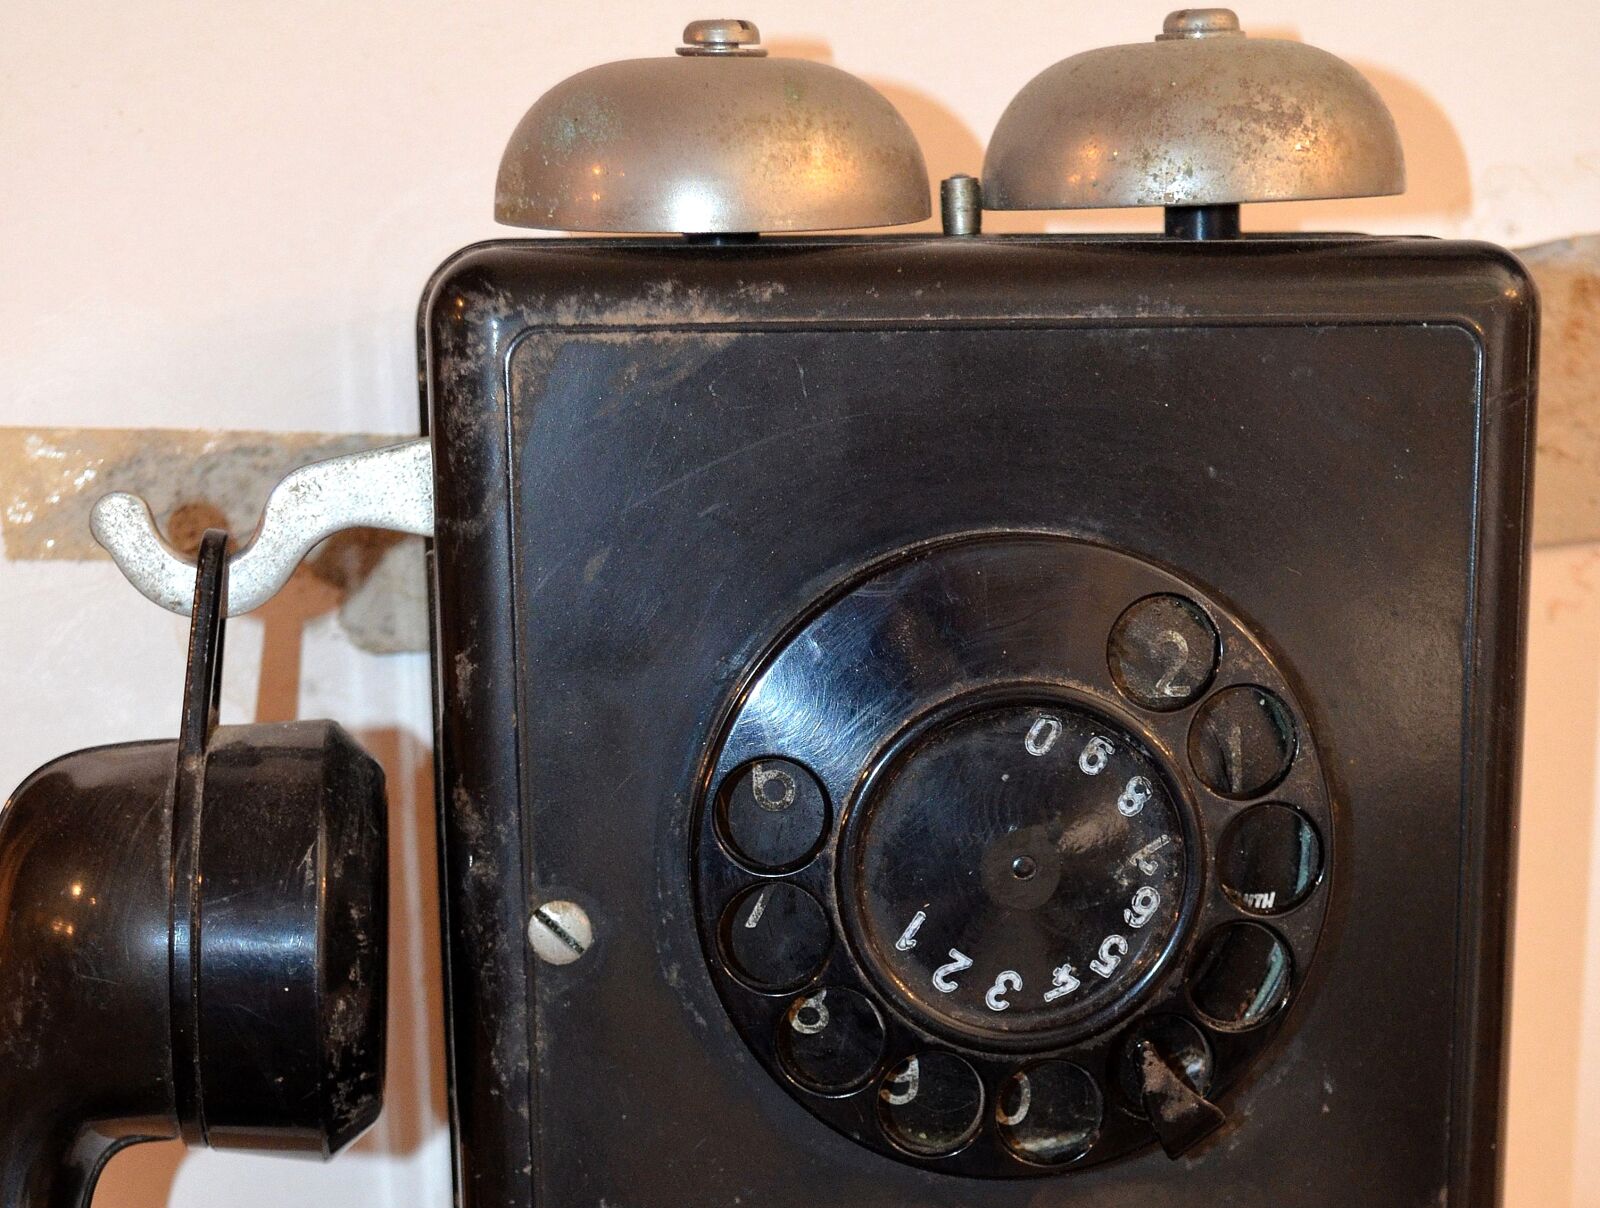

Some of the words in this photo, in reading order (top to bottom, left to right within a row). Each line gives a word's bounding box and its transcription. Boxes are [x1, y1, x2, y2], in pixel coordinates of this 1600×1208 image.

[1155, 629, 1192, 698] 2
[1024, 714, 1063, 757] 0
[1117, 775, 1154, 817] 8
[1129, 834, 1171, 876] 7
[895, 910, 927, 951] 1
[932, 948, 974, 993] 2
[1089, 934, 1129, 979] 5
[985, 969, 1023, 1011] 3
[1043, 963, 1081, 1003] 4
